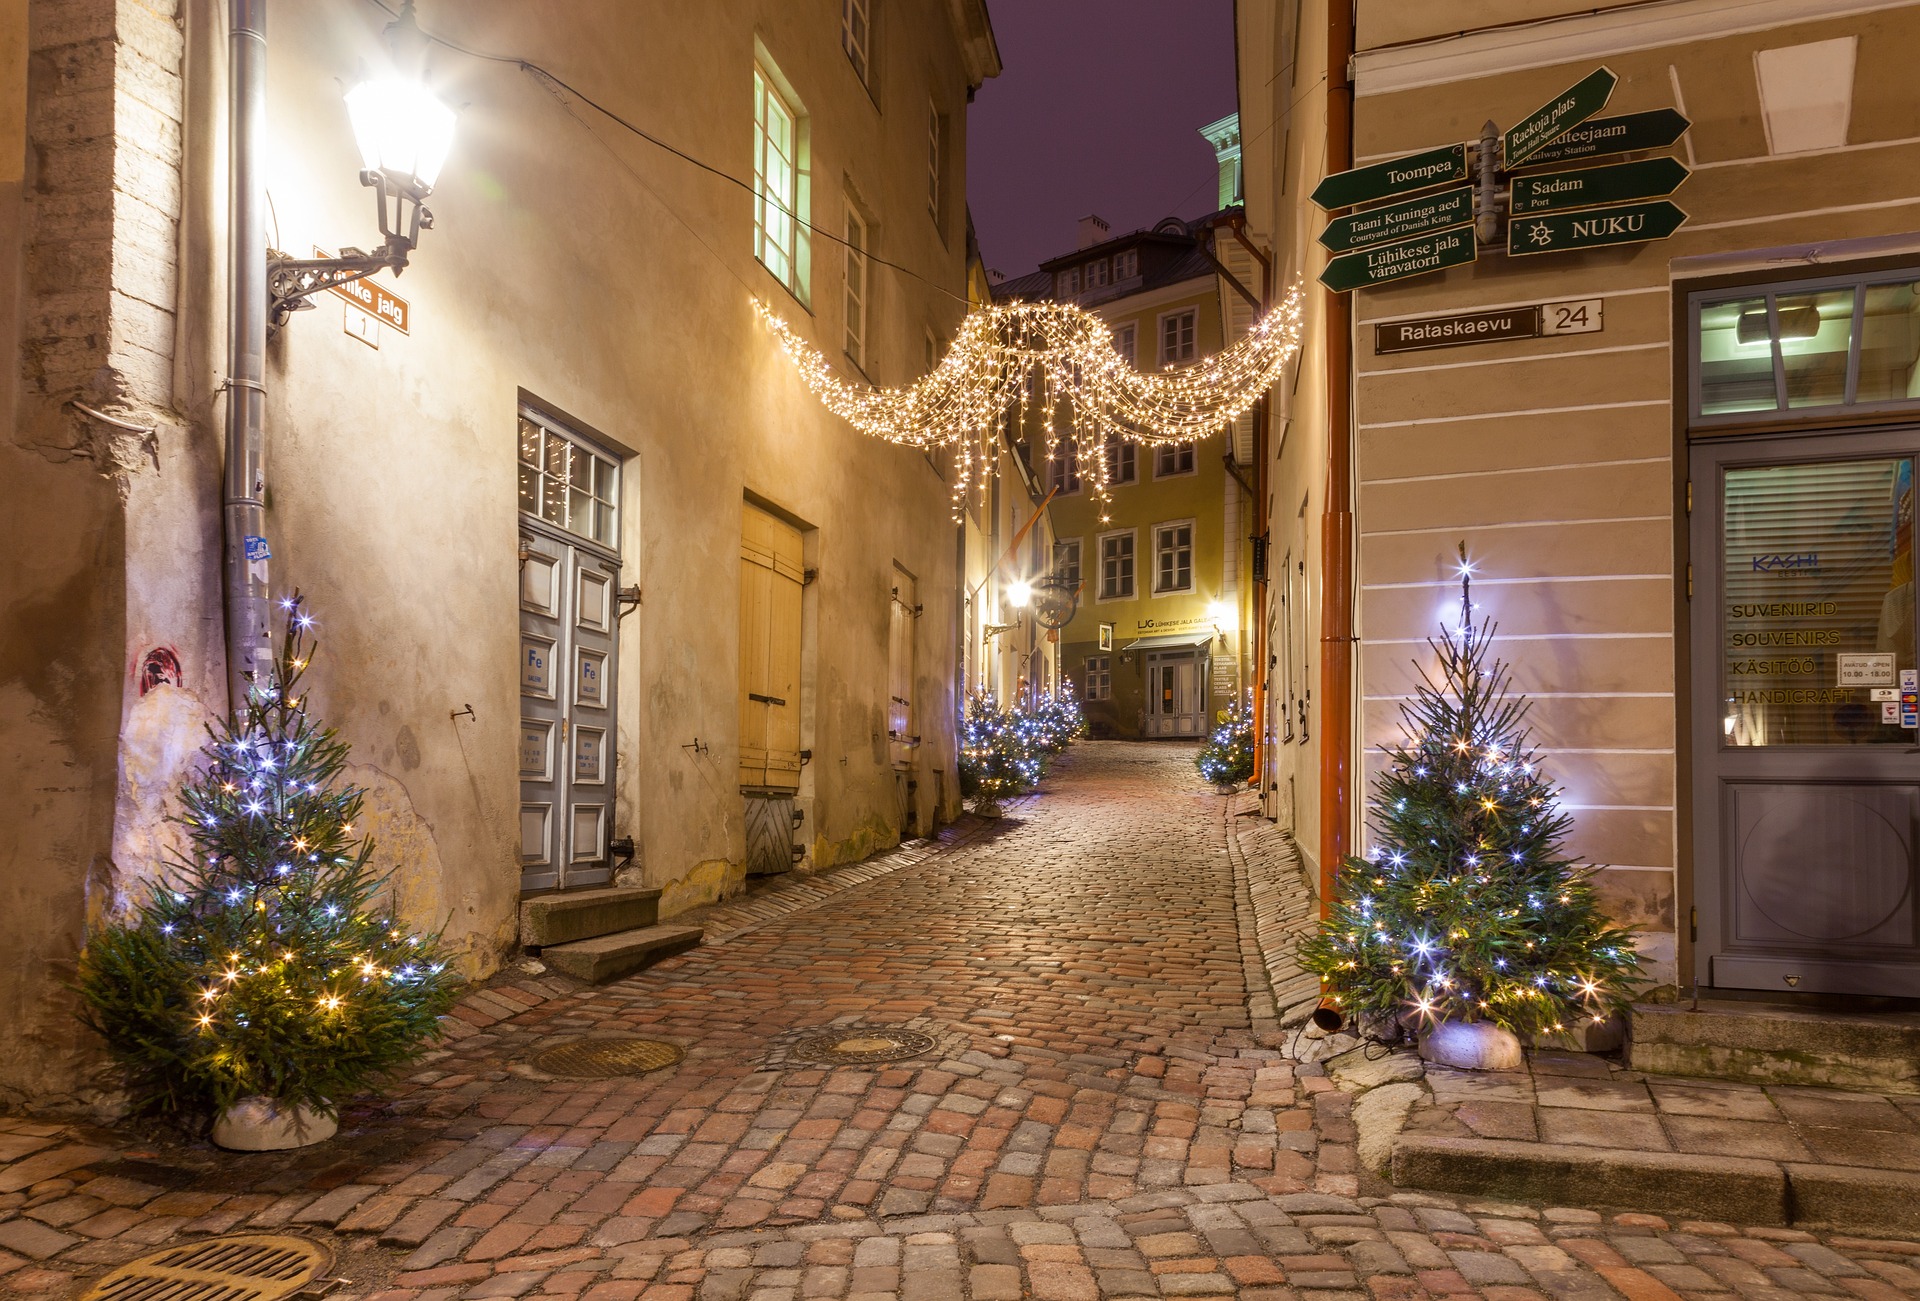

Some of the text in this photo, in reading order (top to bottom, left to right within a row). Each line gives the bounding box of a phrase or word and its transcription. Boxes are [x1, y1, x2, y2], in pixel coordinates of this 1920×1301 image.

[1512, 97, 1576, 147] Raekoja plats
[1512, 124, 1560, 160] Town Hall Square
[1548, 125, 1627, 146] dteejaam
[1564, 144, 1596, 155] Station
[1387, 161, 1452, 184] Toompea
[1532, 179, 1583, 195] Sadam
[1531, 198, 1549, 207] Port
[1350, 197, 1460, 233] Taani Kuninga aed
[1350, 214, 1452, 243] Courtyard of Danish King
[1572, 214, 1646, 239] NUKU
[1368, 235, 1460, 267] Lühikese jala
[1368, 255, 1440, 279] väravatorn
[377, 293, 402, 325] jalg
[1400, 305, 1589, 341] Rataskaevu 24
[1753, 553, 1818, 573] KASHI
[1778, 570, 1807, 578] EESTI
[1732, 602, 1837, 618] SUVENIIRID
[1732, 630, 1840, 647] SOUVENIRS
[528, 649, 542, 668] Fe
[1732, 658, 1815, 675] KÄSITÖÖ
[583, 662, 596, 680] Fe
[1733, 689, 1855, 704] HANDICRAFT
